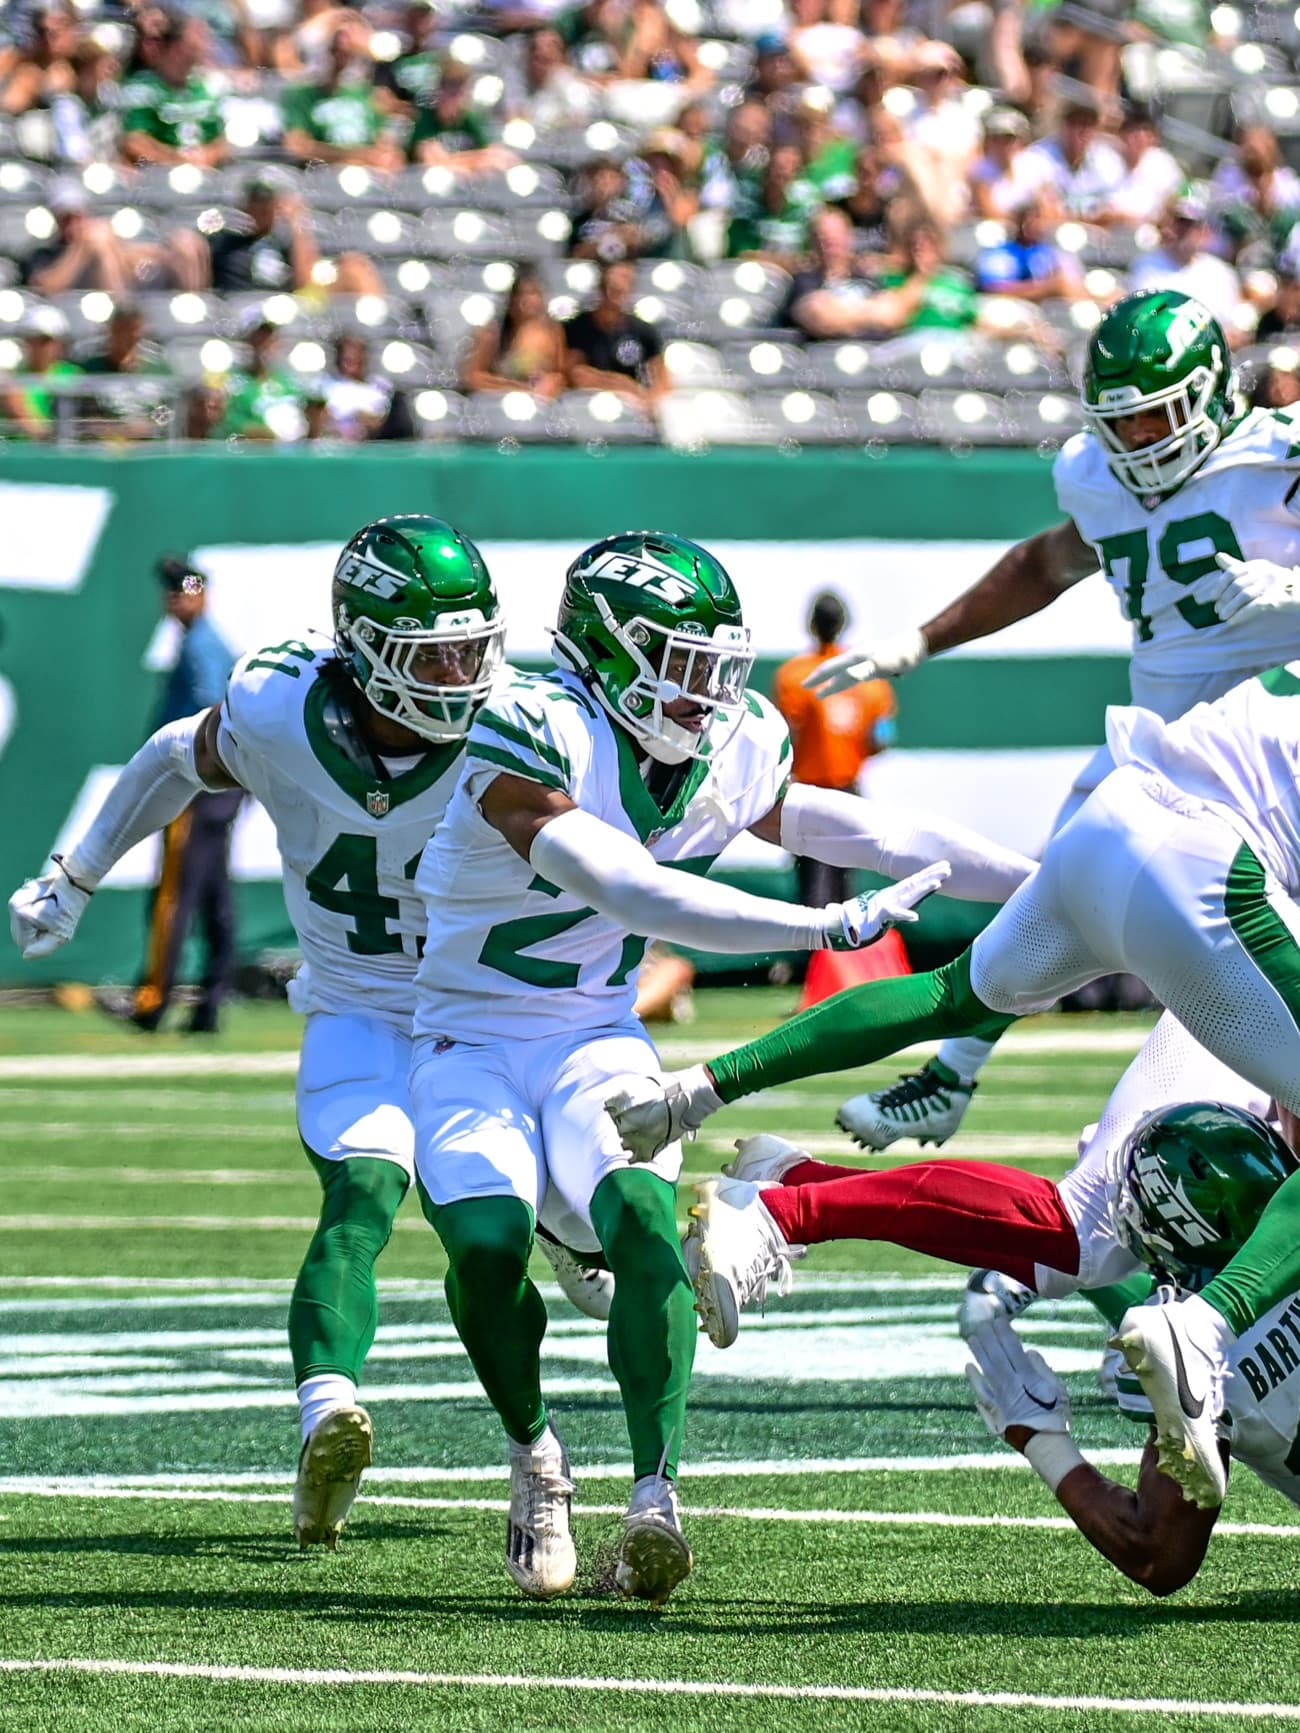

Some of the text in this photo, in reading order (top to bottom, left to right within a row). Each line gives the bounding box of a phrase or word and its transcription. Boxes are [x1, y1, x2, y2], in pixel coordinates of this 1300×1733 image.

[571, 548, 699, 604] JETS
[1096, 510, 1245, 642] 79
[1134, 1150, 1222, 1248] JETS
